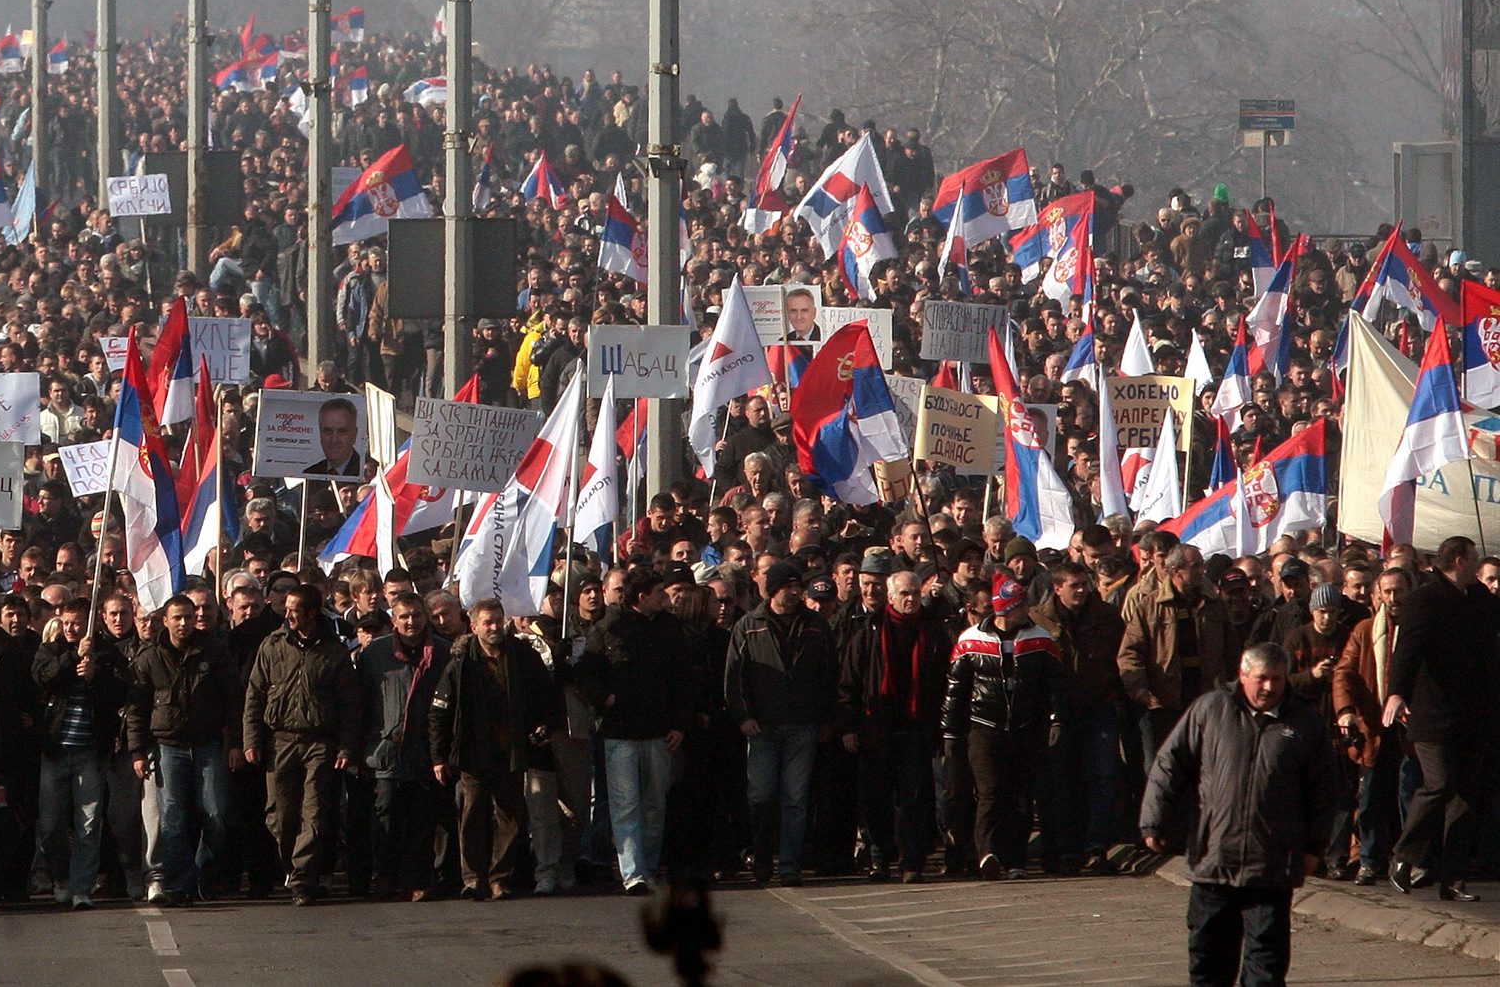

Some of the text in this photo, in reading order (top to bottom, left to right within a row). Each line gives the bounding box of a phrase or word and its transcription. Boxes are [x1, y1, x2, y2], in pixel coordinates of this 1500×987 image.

[110, 178, 167, 196] СРБИЈО
[115, 199, 168, 214] КЛЕЧИ
[600, 344, 678, 380] ШАБАЦ
[1114, 384, 1179, 401] ХОЋЕМО
[417, 400, 527, 432] ВИ СТЕ ТИТАНИК
[421, 420, 441, 439] ЗА
[420, 439, 484, 463] СРБИЈА
[930, 440, 975, 464] ДАНАС
